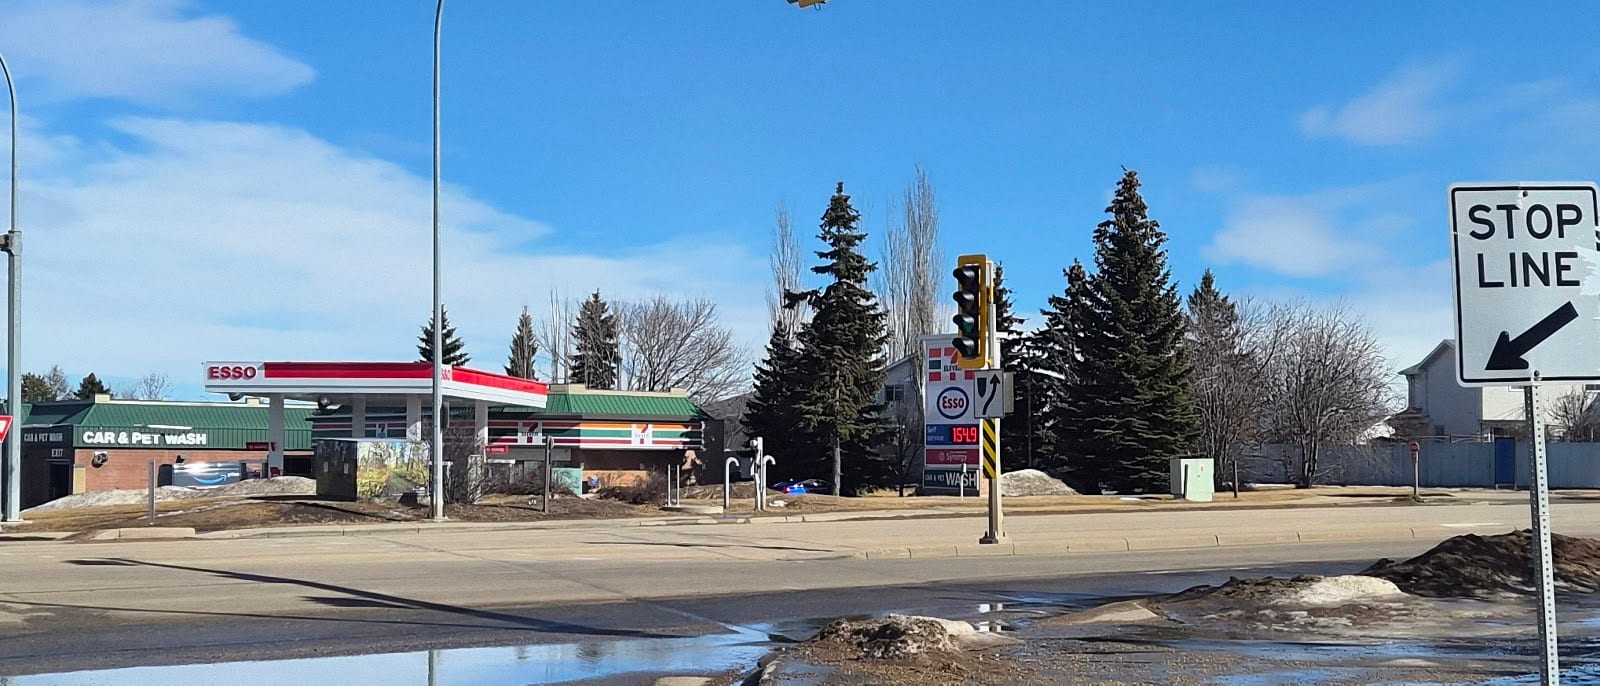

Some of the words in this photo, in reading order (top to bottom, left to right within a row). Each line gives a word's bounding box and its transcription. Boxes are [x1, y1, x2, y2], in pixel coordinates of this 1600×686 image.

[1468, 203, 1583, 240] STOP
[1477, 252, 1581, 288] LINE
[207, 365, 257, 380] ESSO
[942, 395, 965, 409] Esso
[38, 432, 48, 442] PET
[82, 431, 116, 444] CAR
[117, 431, 129, 444] &
[131, 432, 161, 445] PET
[164, 432, 207, 445] WASH
[952, 427, 977, 443] 154.9
[51, 448, 64, 457] EXIT
[945, 471, 977, 487] WASH
